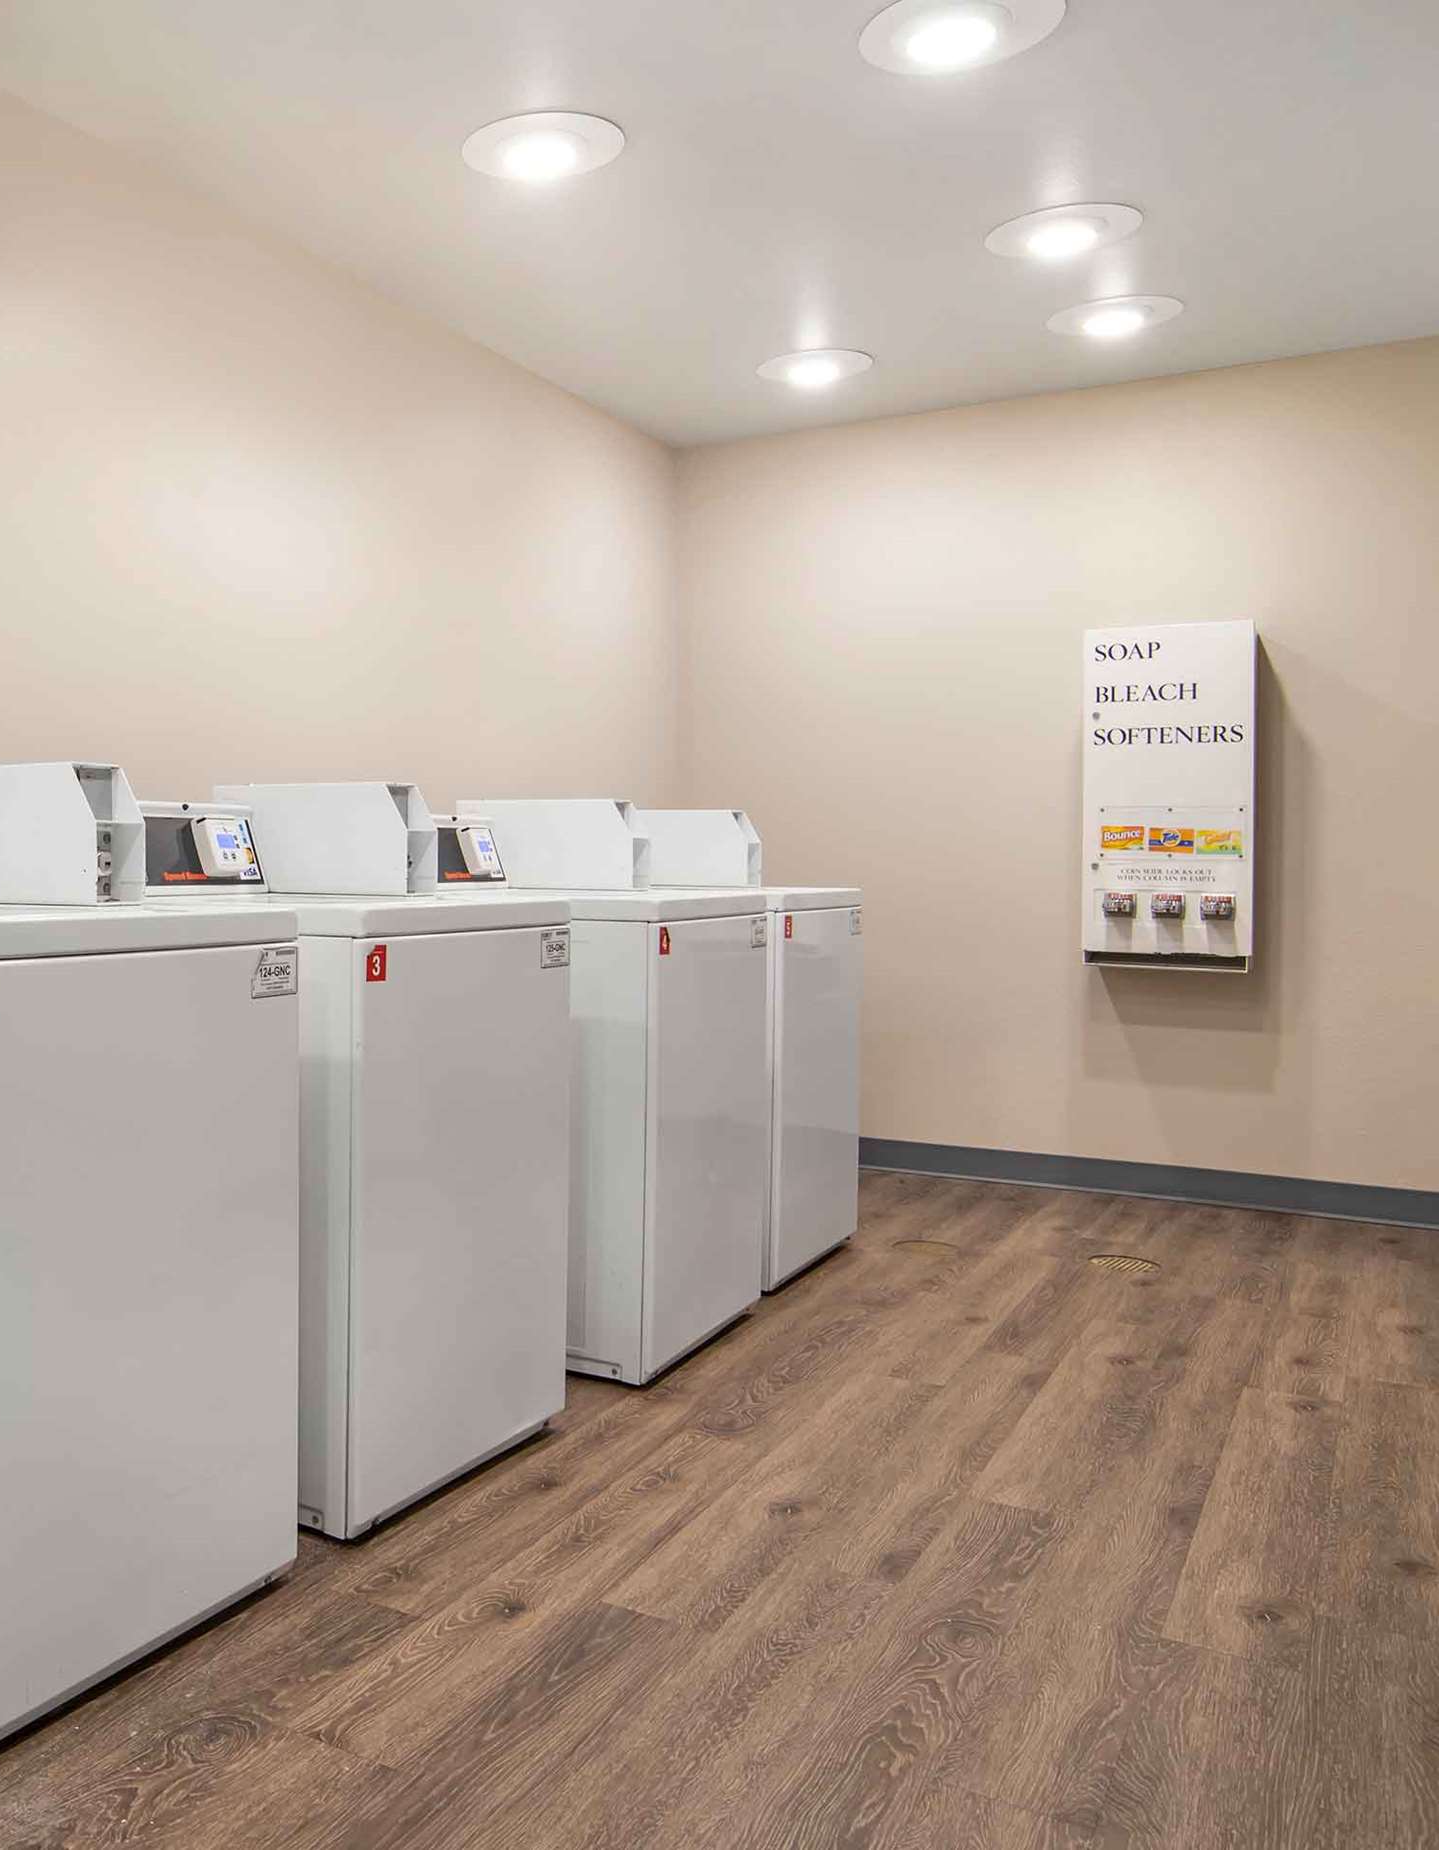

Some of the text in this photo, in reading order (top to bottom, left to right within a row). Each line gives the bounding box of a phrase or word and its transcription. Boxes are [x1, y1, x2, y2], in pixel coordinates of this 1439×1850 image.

[1094, 641, 1161, 662] SOAP
[1095, 683, 1198, 704] BLEACH
[1093, 724, 1244, 746] SOFTENERS
[1103, 829, 1141, 842] Bounce
[1162, 832, 1180, 844] Tide
[259, 965, 291, 977] 124-GNC
[372, 955, 381, 976] 3
